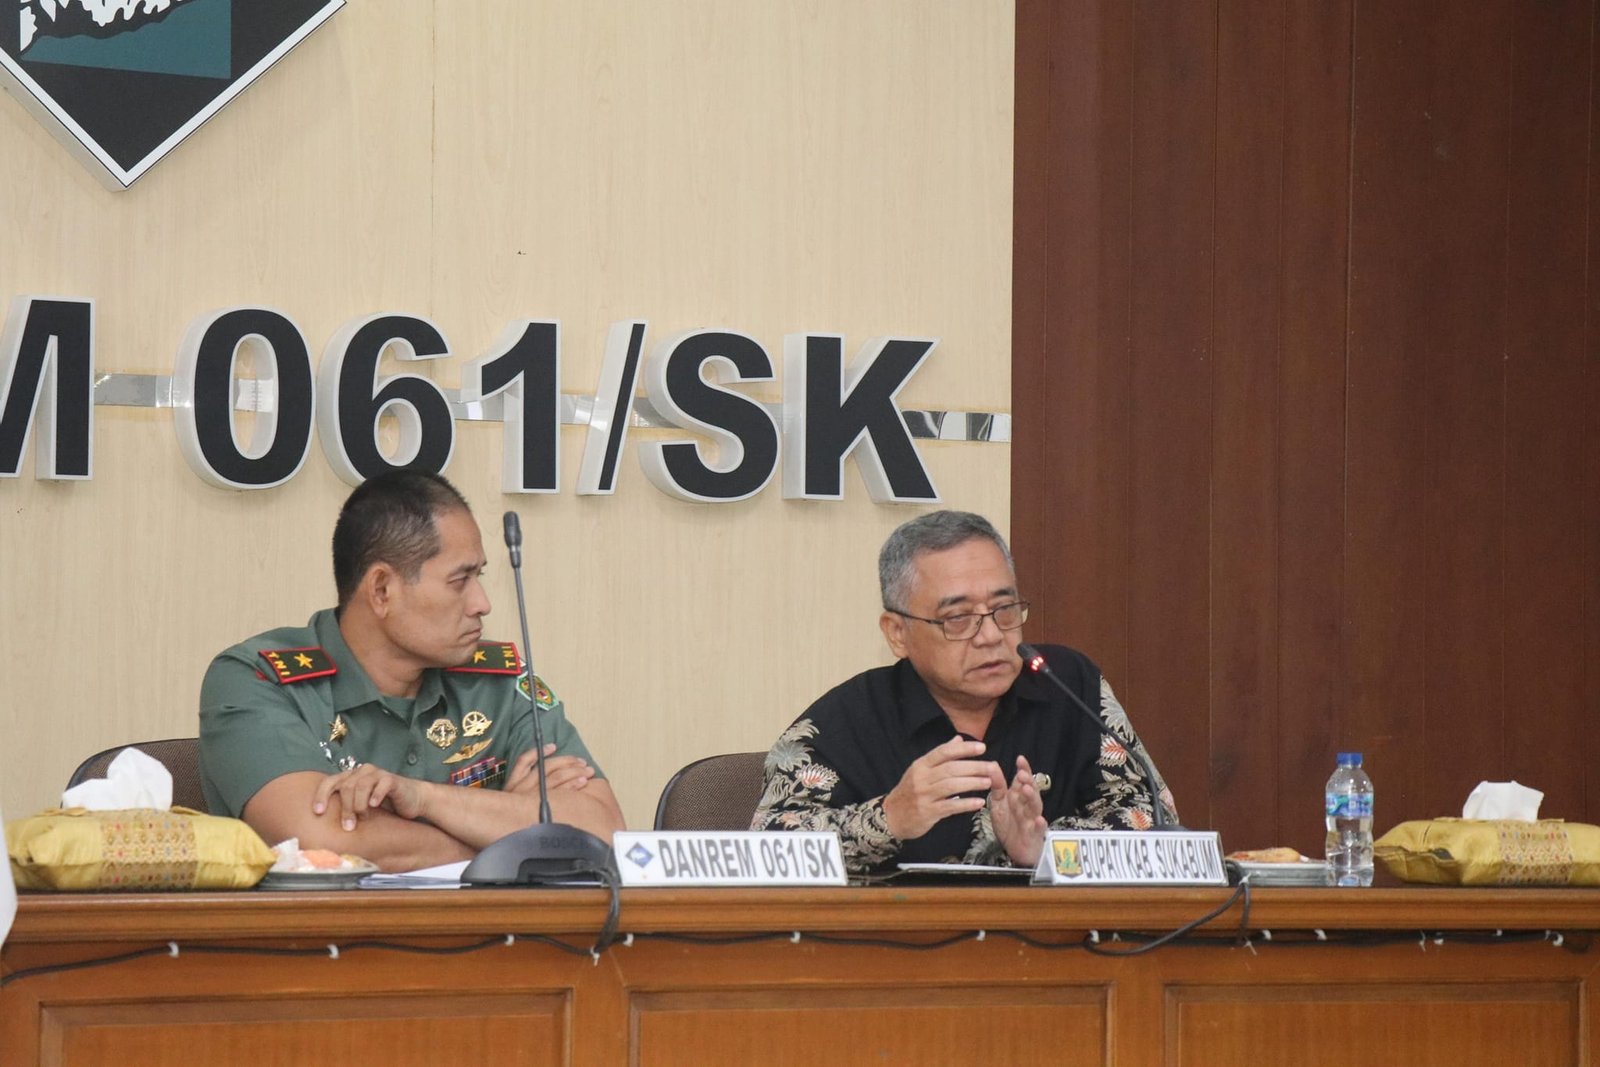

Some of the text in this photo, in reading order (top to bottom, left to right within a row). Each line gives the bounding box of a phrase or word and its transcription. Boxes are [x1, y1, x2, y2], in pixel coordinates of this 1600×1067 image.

[185, 308, 941, 503] 061/SK
[268, 651, 291, 676] TNI
[501, 645, 517, 668] TNI
[658, 838, 839, 879] DANREM 061/SK
[1080, 838, 1222, 879] BUPATI KAB. SUKABUMI
